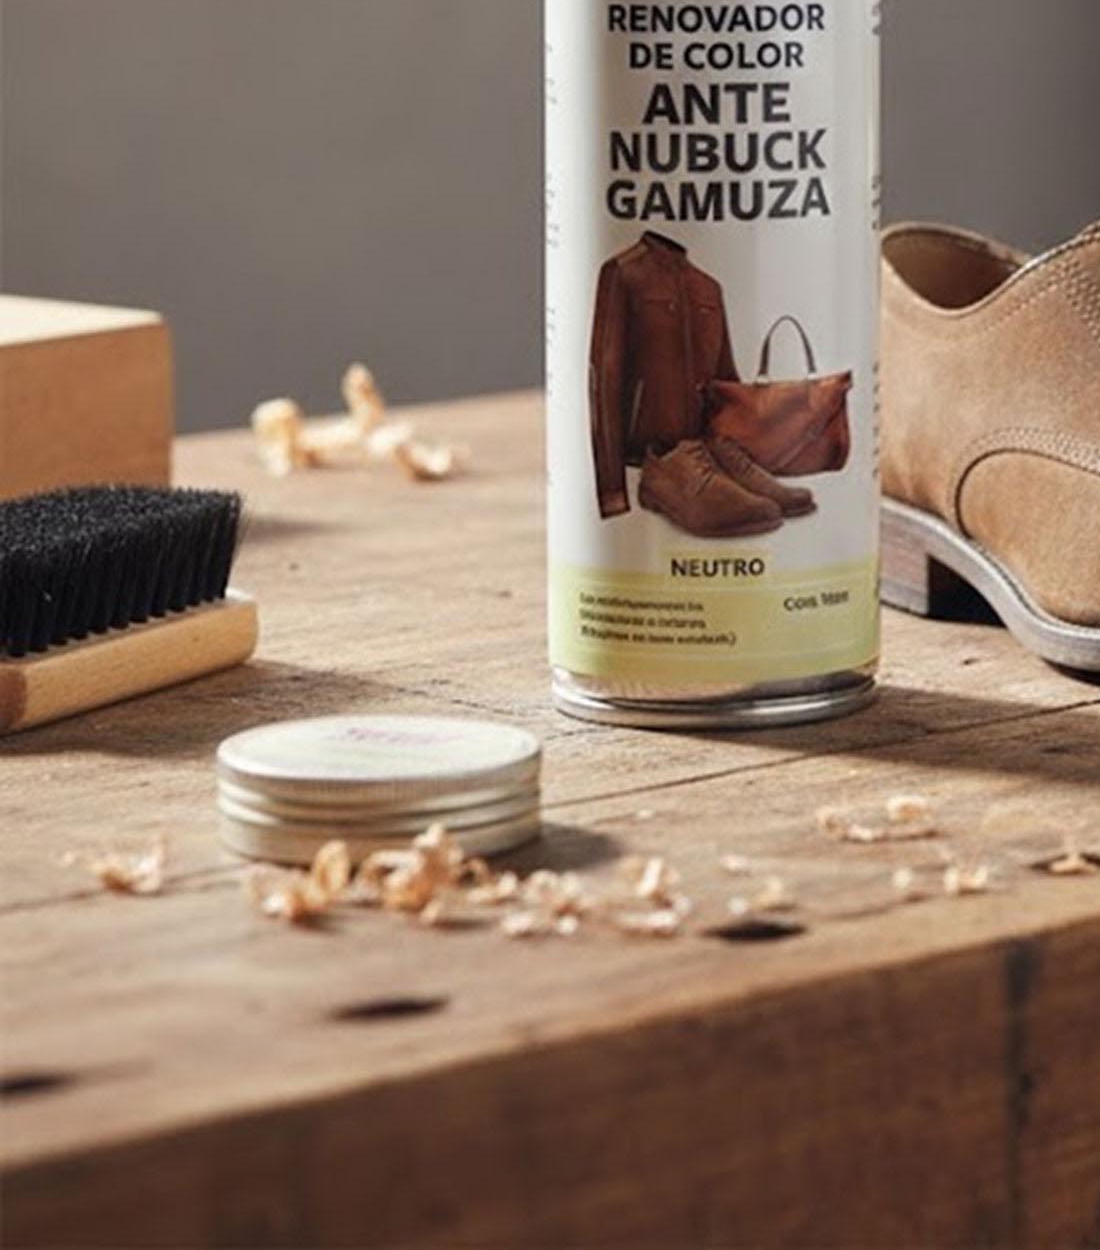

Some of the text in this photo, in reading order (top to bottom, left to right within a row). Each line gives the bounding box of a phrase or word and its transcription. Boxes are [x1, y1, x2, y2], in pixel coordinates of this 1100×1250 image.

[608, 4, 825, 33] RENOVADOR
[629, 42, 804, 69] DE COLOR
[642, 82, 791, 125] ANTE
[610, 129, 827, 173] NUBUCK
[606, 177, 831, 221] GAMUZA
[670, 558, 765, 578] NEUTRO
